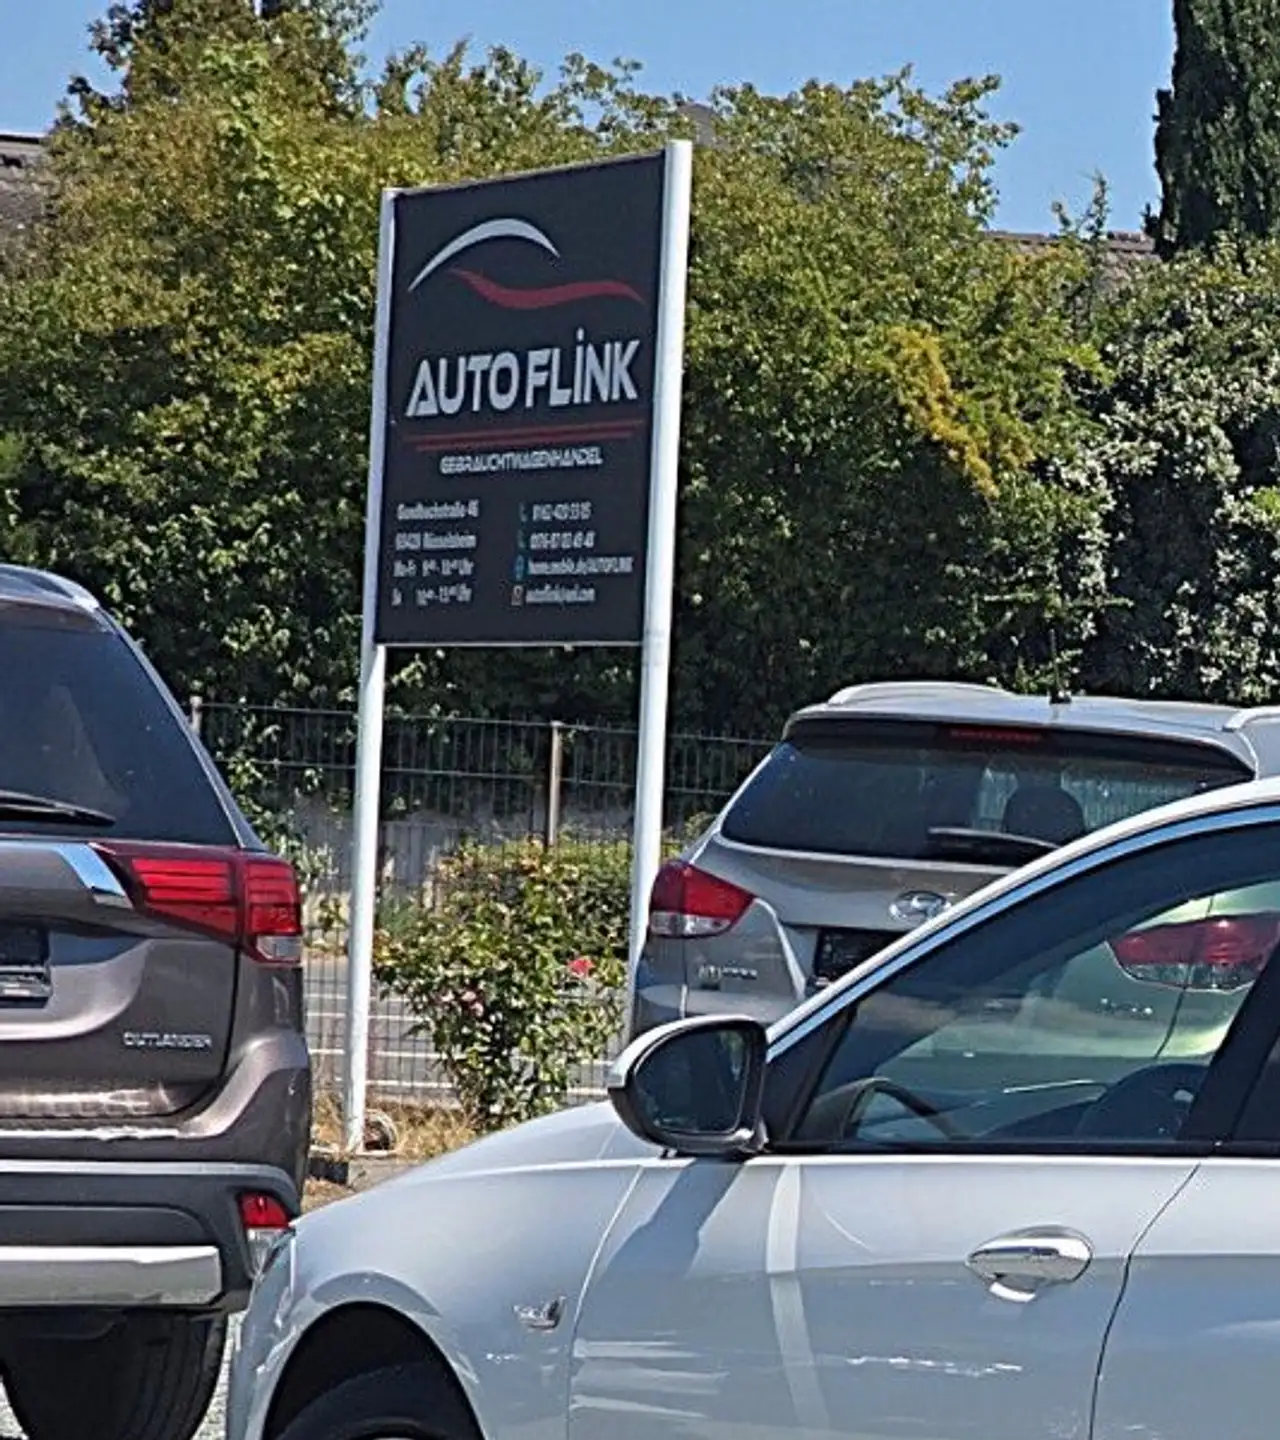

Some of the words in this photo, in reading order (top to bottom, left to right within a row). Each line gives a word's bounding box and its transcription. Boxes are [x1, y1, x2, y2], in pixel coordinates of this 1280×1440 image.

[404, 351, 520, 417] AUTO
[440, 446, 604, 474] GEBRAUCHTWAGENHANDEL
[123, 1031, 213, 1048] OUTLANDER
